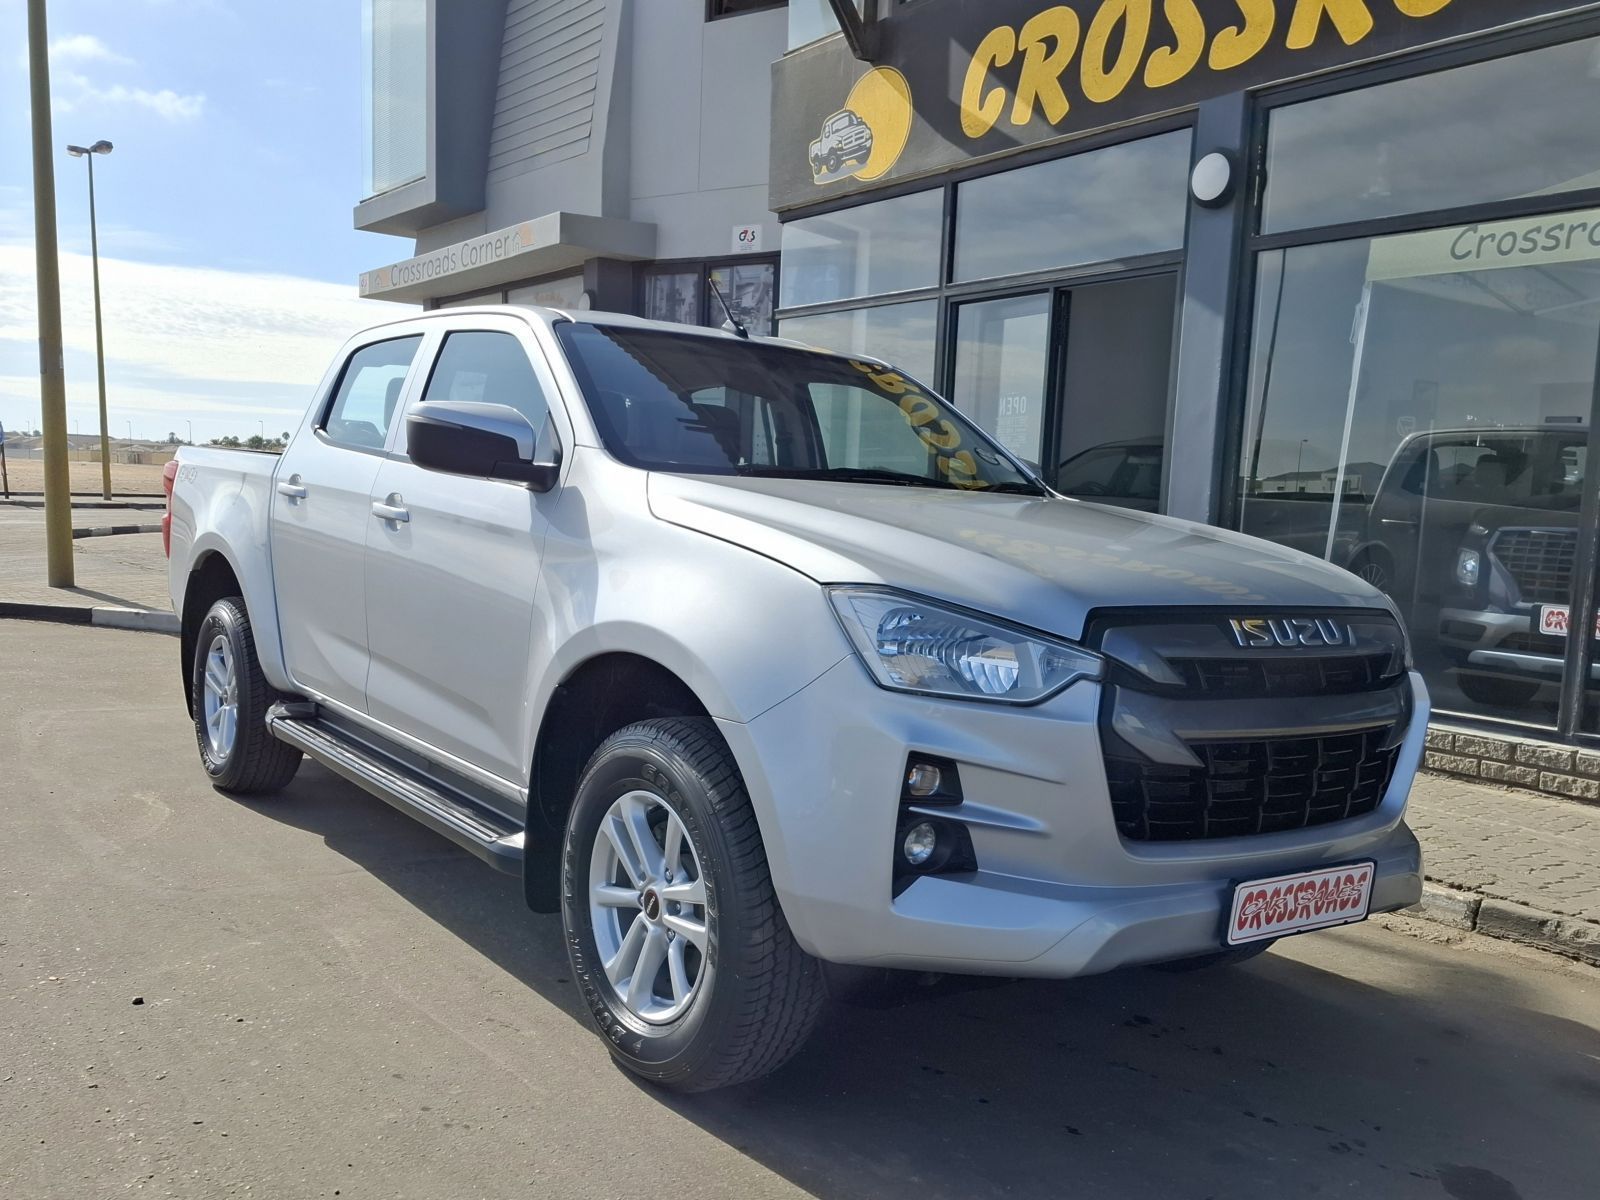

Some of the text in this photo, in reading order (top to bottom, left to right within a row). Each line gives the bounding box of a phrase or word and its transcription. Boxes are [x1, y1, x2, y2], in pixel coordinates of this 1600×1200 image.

[390, 234, 510, 287] Crossroads Corner
[1229, 618, 1343, 647] ISUZU
[1236, 871, 1368, 931] CROSSROADS
[1241, 883, 1364, 917] CAR SALES
